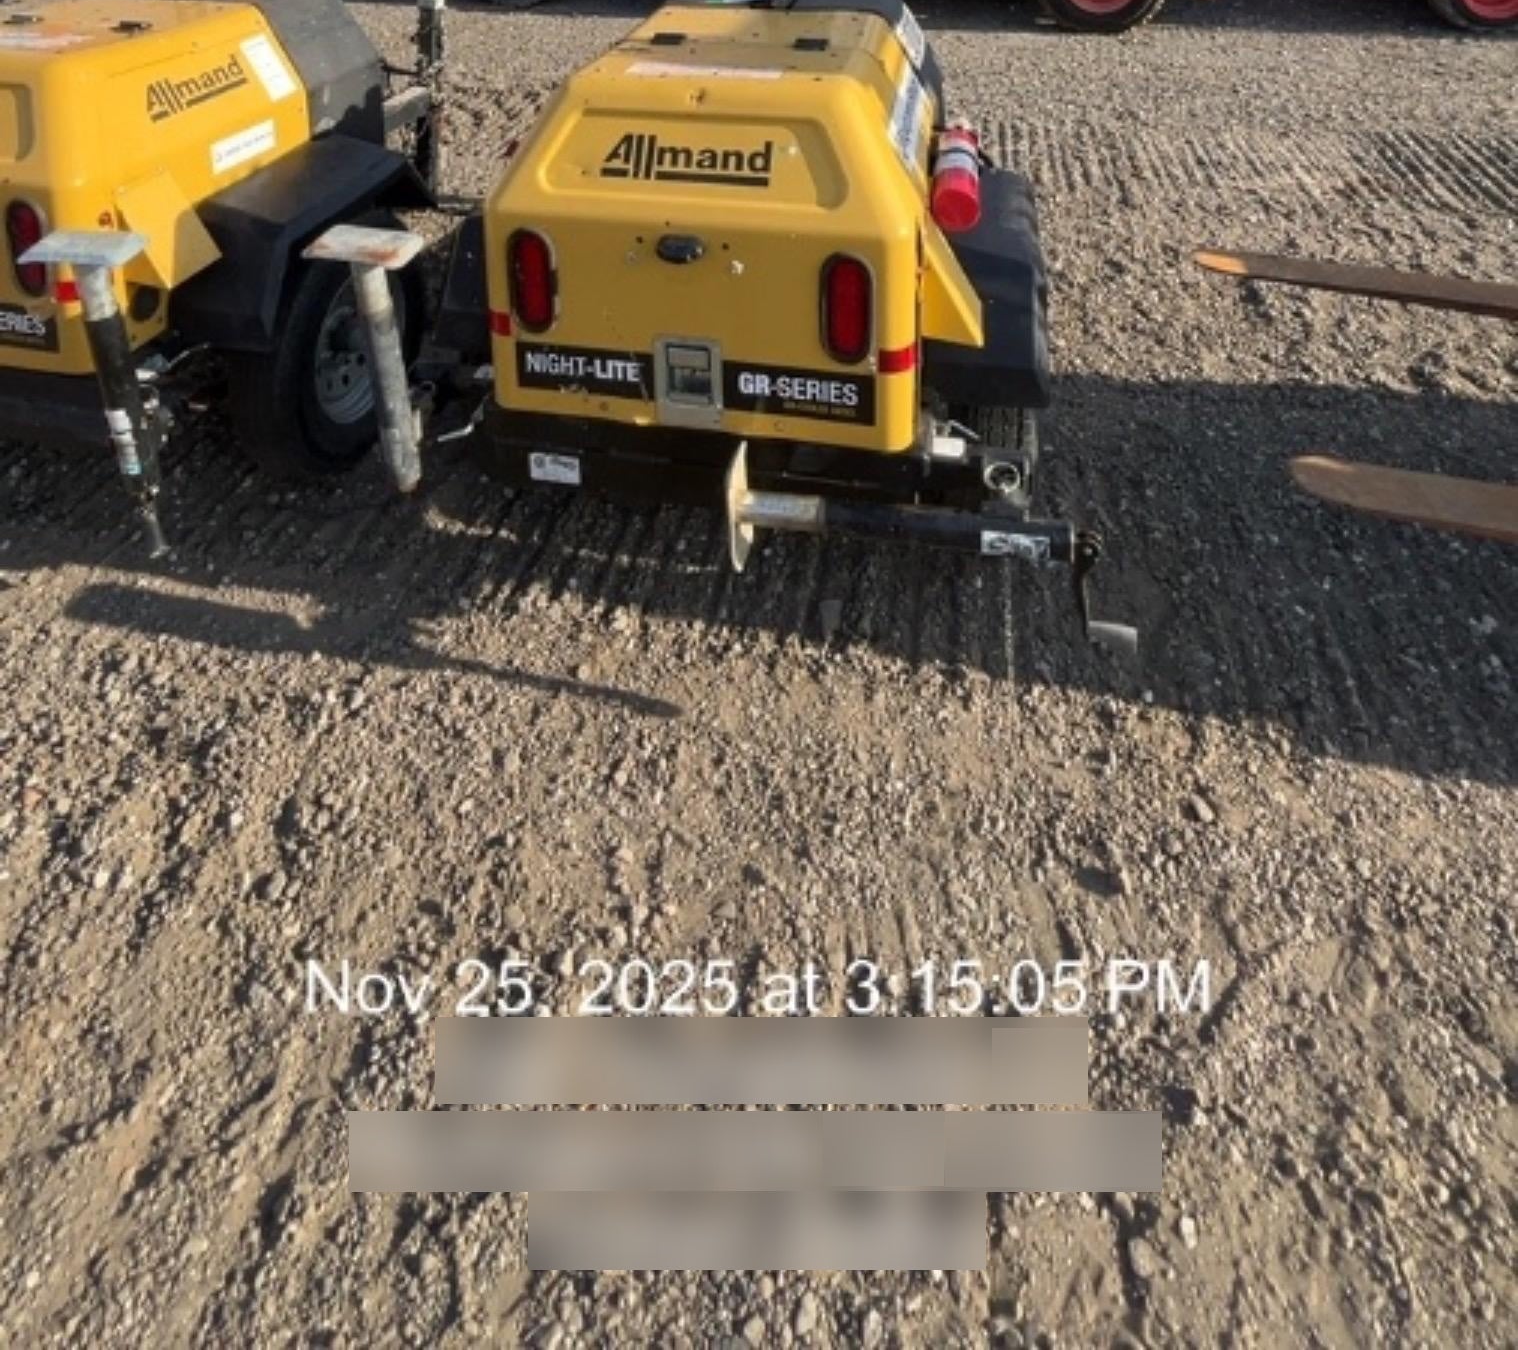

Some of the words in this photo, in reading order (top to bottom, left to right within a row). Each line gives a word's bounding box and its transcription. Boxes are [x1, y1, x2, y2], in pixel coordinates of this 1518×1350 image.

[146, 53, 247, 123] Allmand
[601, 132, 772, 187] Allmand
[524, 351, 641, 383] NIGHT-LITE
[737, 370, 859, 407] GR-SERIES
